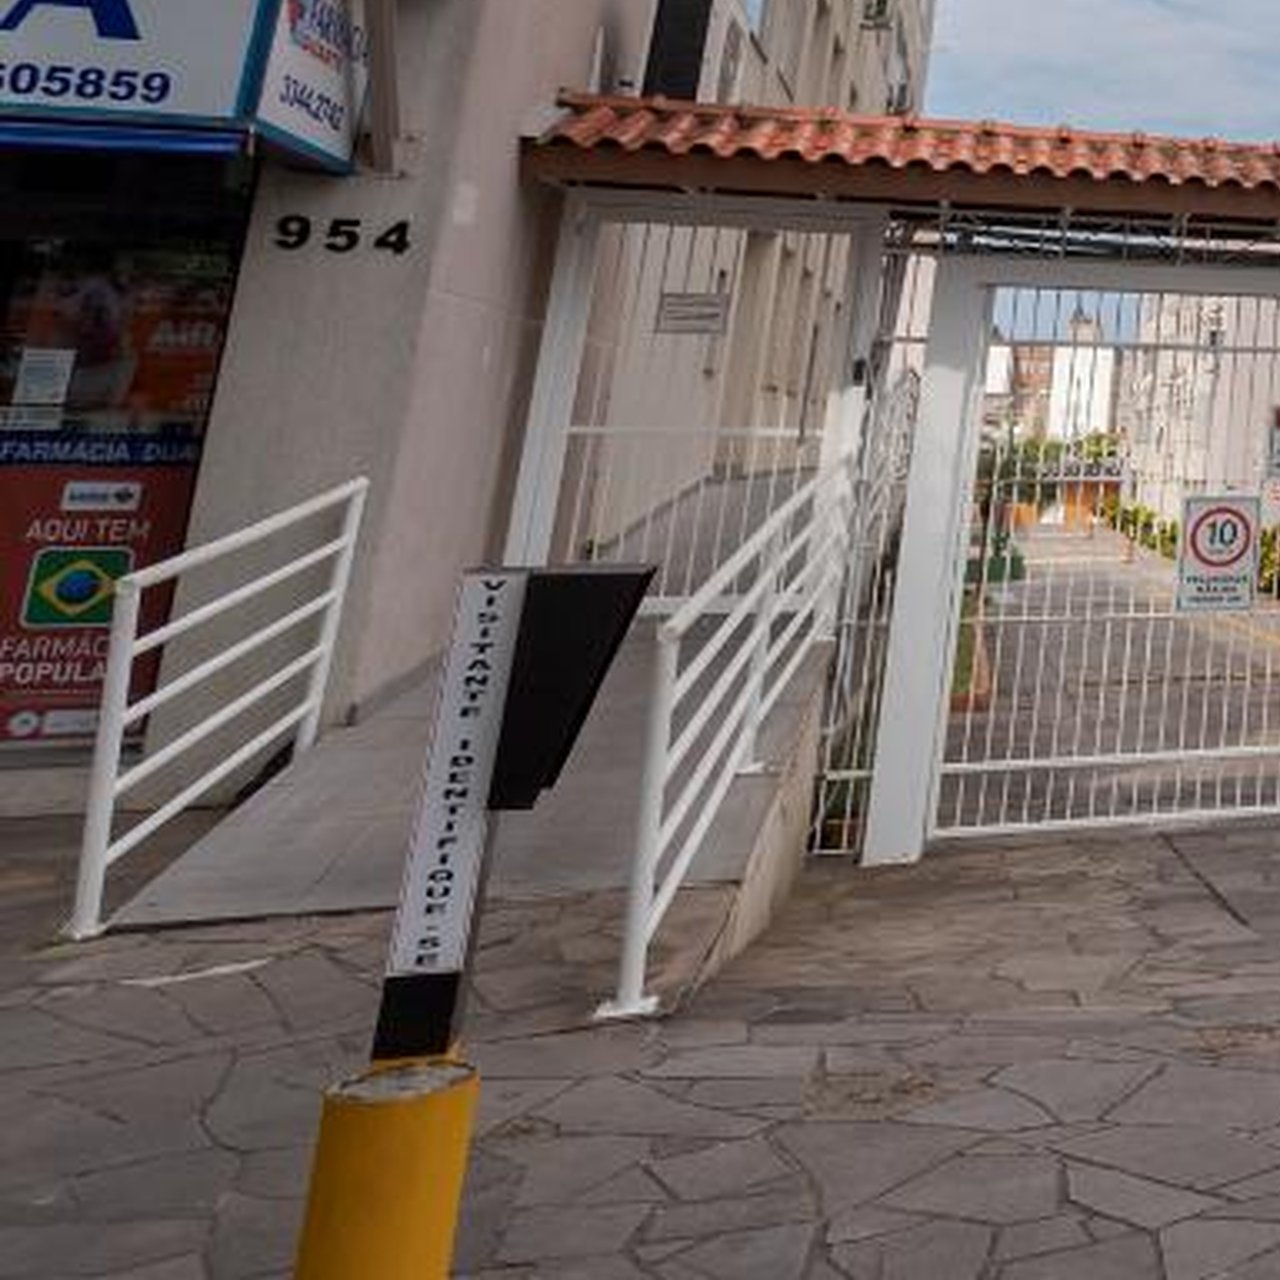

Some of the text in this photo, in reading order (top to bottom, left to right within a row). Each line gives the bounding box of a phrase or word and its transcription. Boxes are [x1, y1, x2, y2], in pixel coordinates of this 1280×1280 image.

[274, 213, 411, 256] 954
[25, 518, 151, 541] AQUI TEM
[1206, 519, 1238, 547] 10
[458, 577, 507, 719] VISITANTE
[0, 662, 108, 687] POPULA
